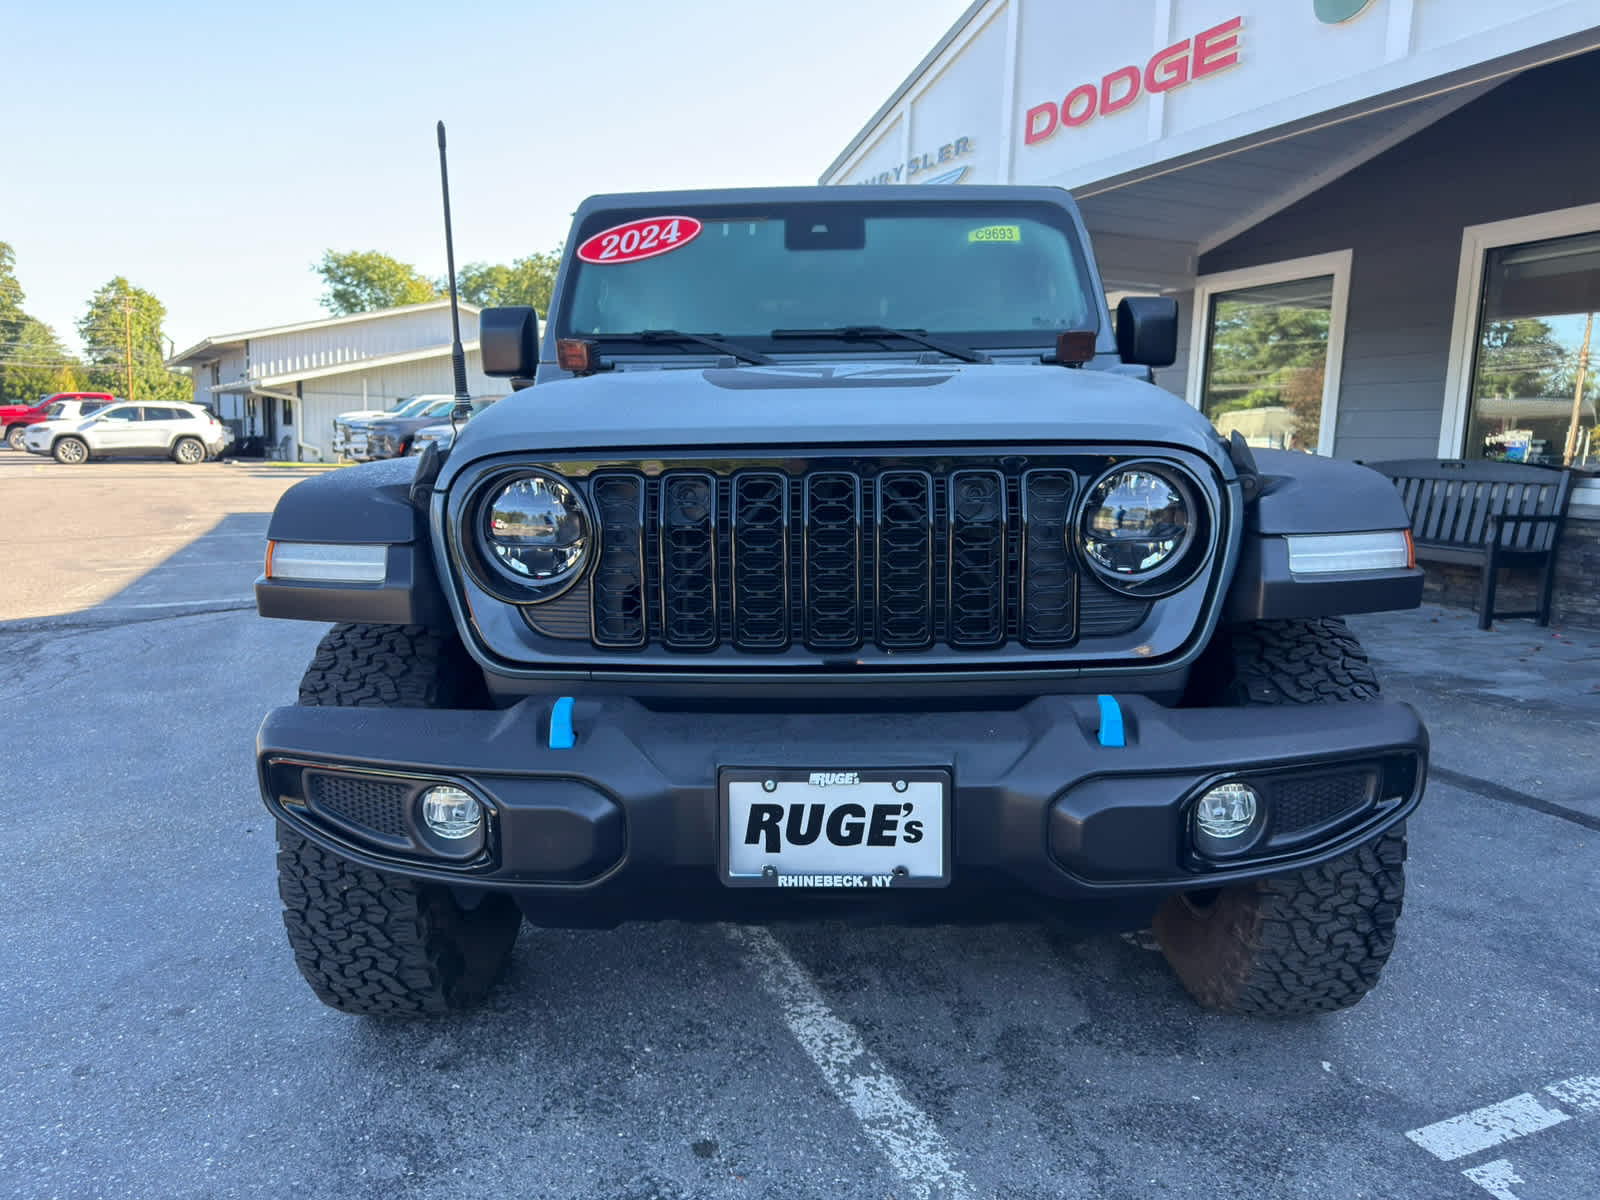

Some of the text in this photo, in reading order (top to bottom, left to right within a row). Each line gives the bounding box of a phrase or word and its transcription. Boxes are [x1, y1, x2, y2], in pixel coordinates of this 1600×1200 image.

[1024, 16, 1242, 146] DODGE
[857, 136, 969, 184] RYSLER
[599, 219, 682, 259] 2024
[975, 227, 1014, 240] C9693
[744, 802, 924, 853] RUGE's
[777, 875, 893, 888] RHINEBECK, NY
